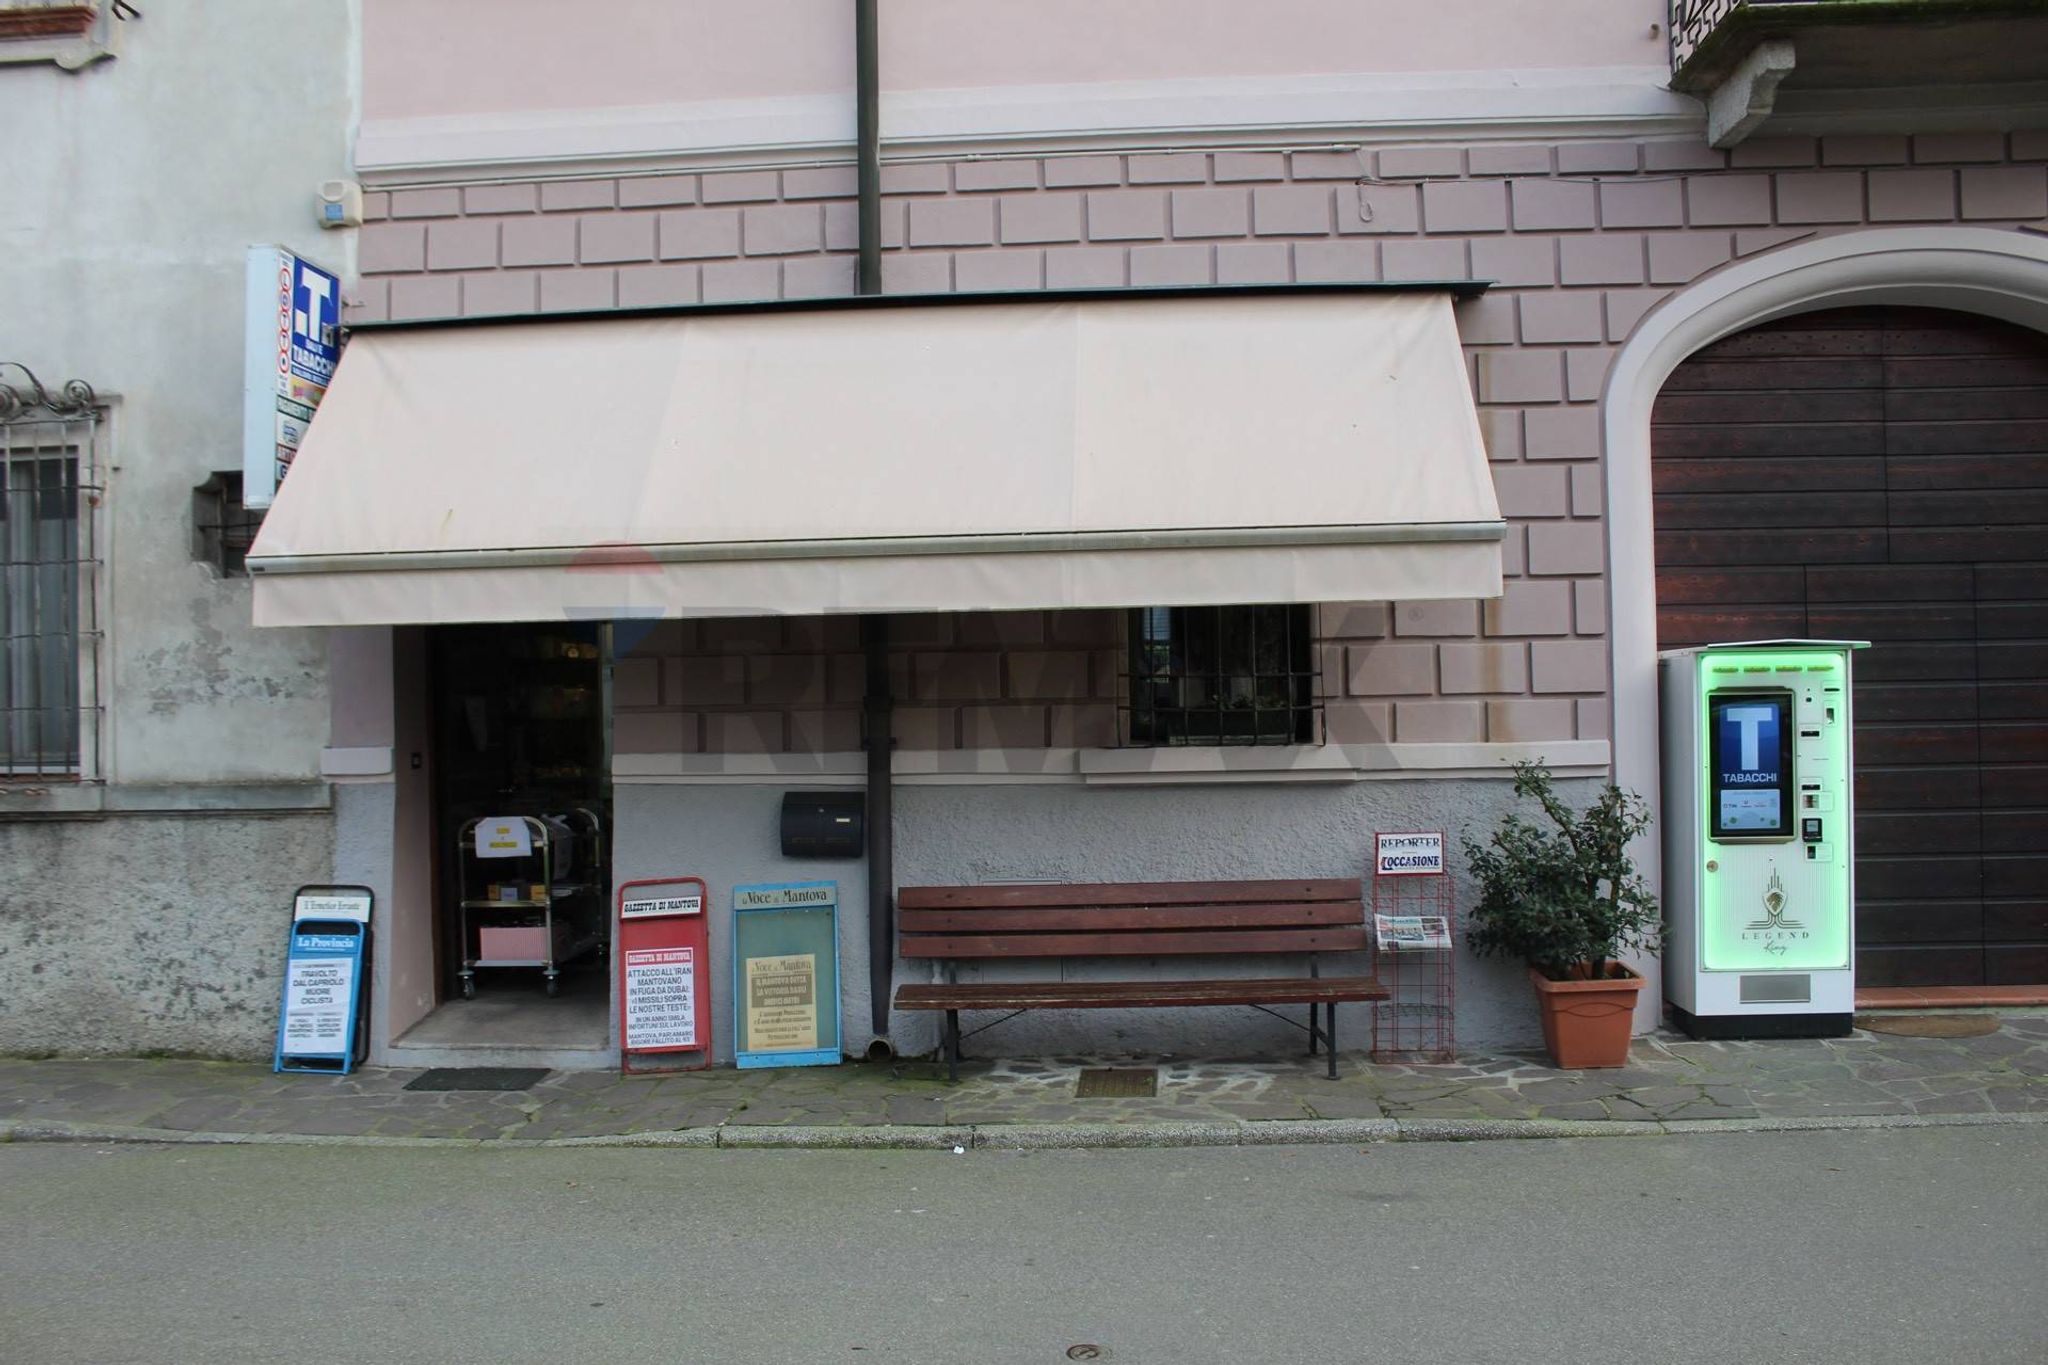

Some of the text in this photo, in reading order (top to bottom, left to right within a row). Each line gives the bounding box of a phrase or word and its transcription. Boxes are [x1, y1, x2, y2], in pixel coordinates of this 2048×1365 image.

[1726, 707, 1773, 771] T
[1722, 773, 1778, 784] TABACCHI
[1381, 837, 1440, 849] REPORTER
[747, 892, 771, 904] Voce
[783, 890, 827, 903] Mantova
[624, 899, 699, 913] GAZZETTA DI MANTOVA
[1742, 932, 1810, 940] LEGEND
[297, 937, 354, 948] La Provincia
[628, 967, 692, 978] ATTACCO ALL'IRAN
[637, 977, 682, 986] MANTOVANO
[638, 987, 656, 995] FUGA
[664, 994, 687, 1002] SOPRA
[638, 1004, 666, 1013] NOSTRE
